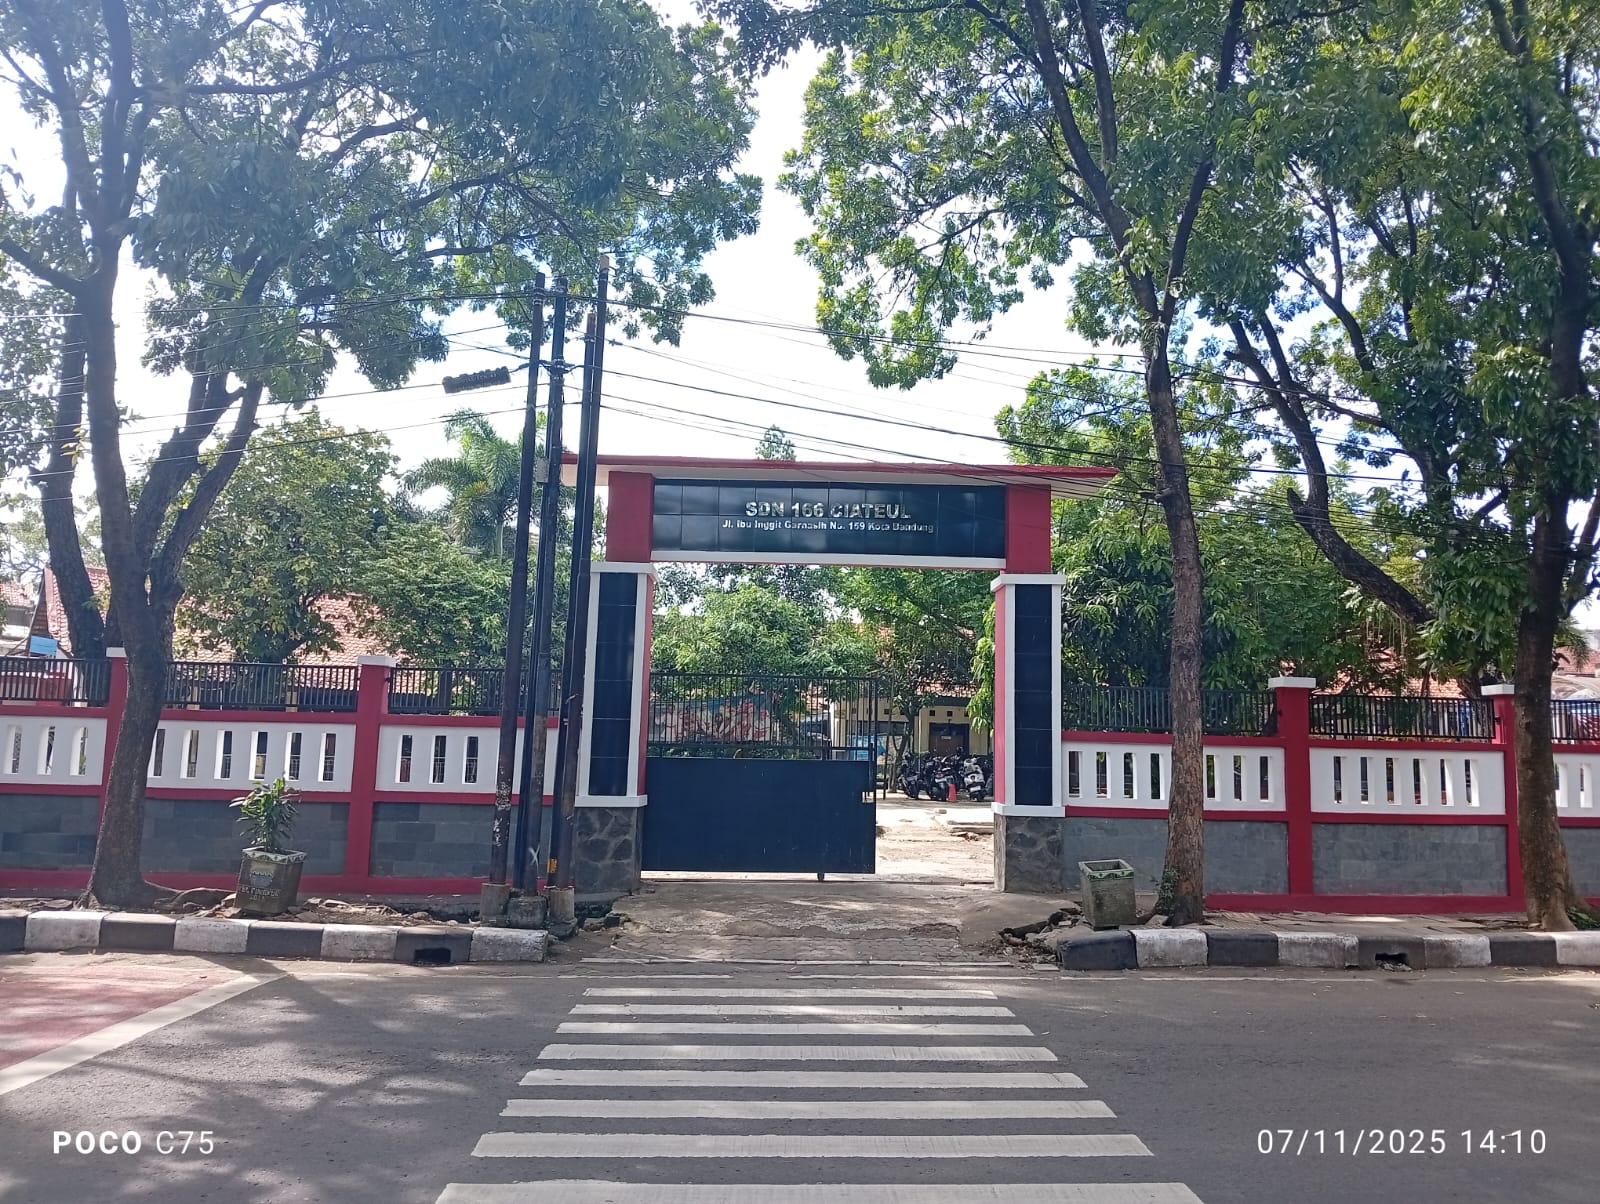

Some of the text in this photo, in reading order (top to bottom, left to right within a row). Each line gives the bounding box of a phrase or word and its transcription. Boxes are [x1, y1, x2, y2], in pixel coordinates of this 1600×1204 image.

[745, 501, 912, 519] SDN 166 CIATEUL
[722, 519, 734, 529] Jl.
[736, 519, 752, 529] Ibu
[754, 520, 782, 531] Inggit
[784, 520, 827, 530] Garnasih
[829, 521, 846, 530] No.
[867, 522, 890, 531] Kota
[892, 522, 934, 534] Bandung
